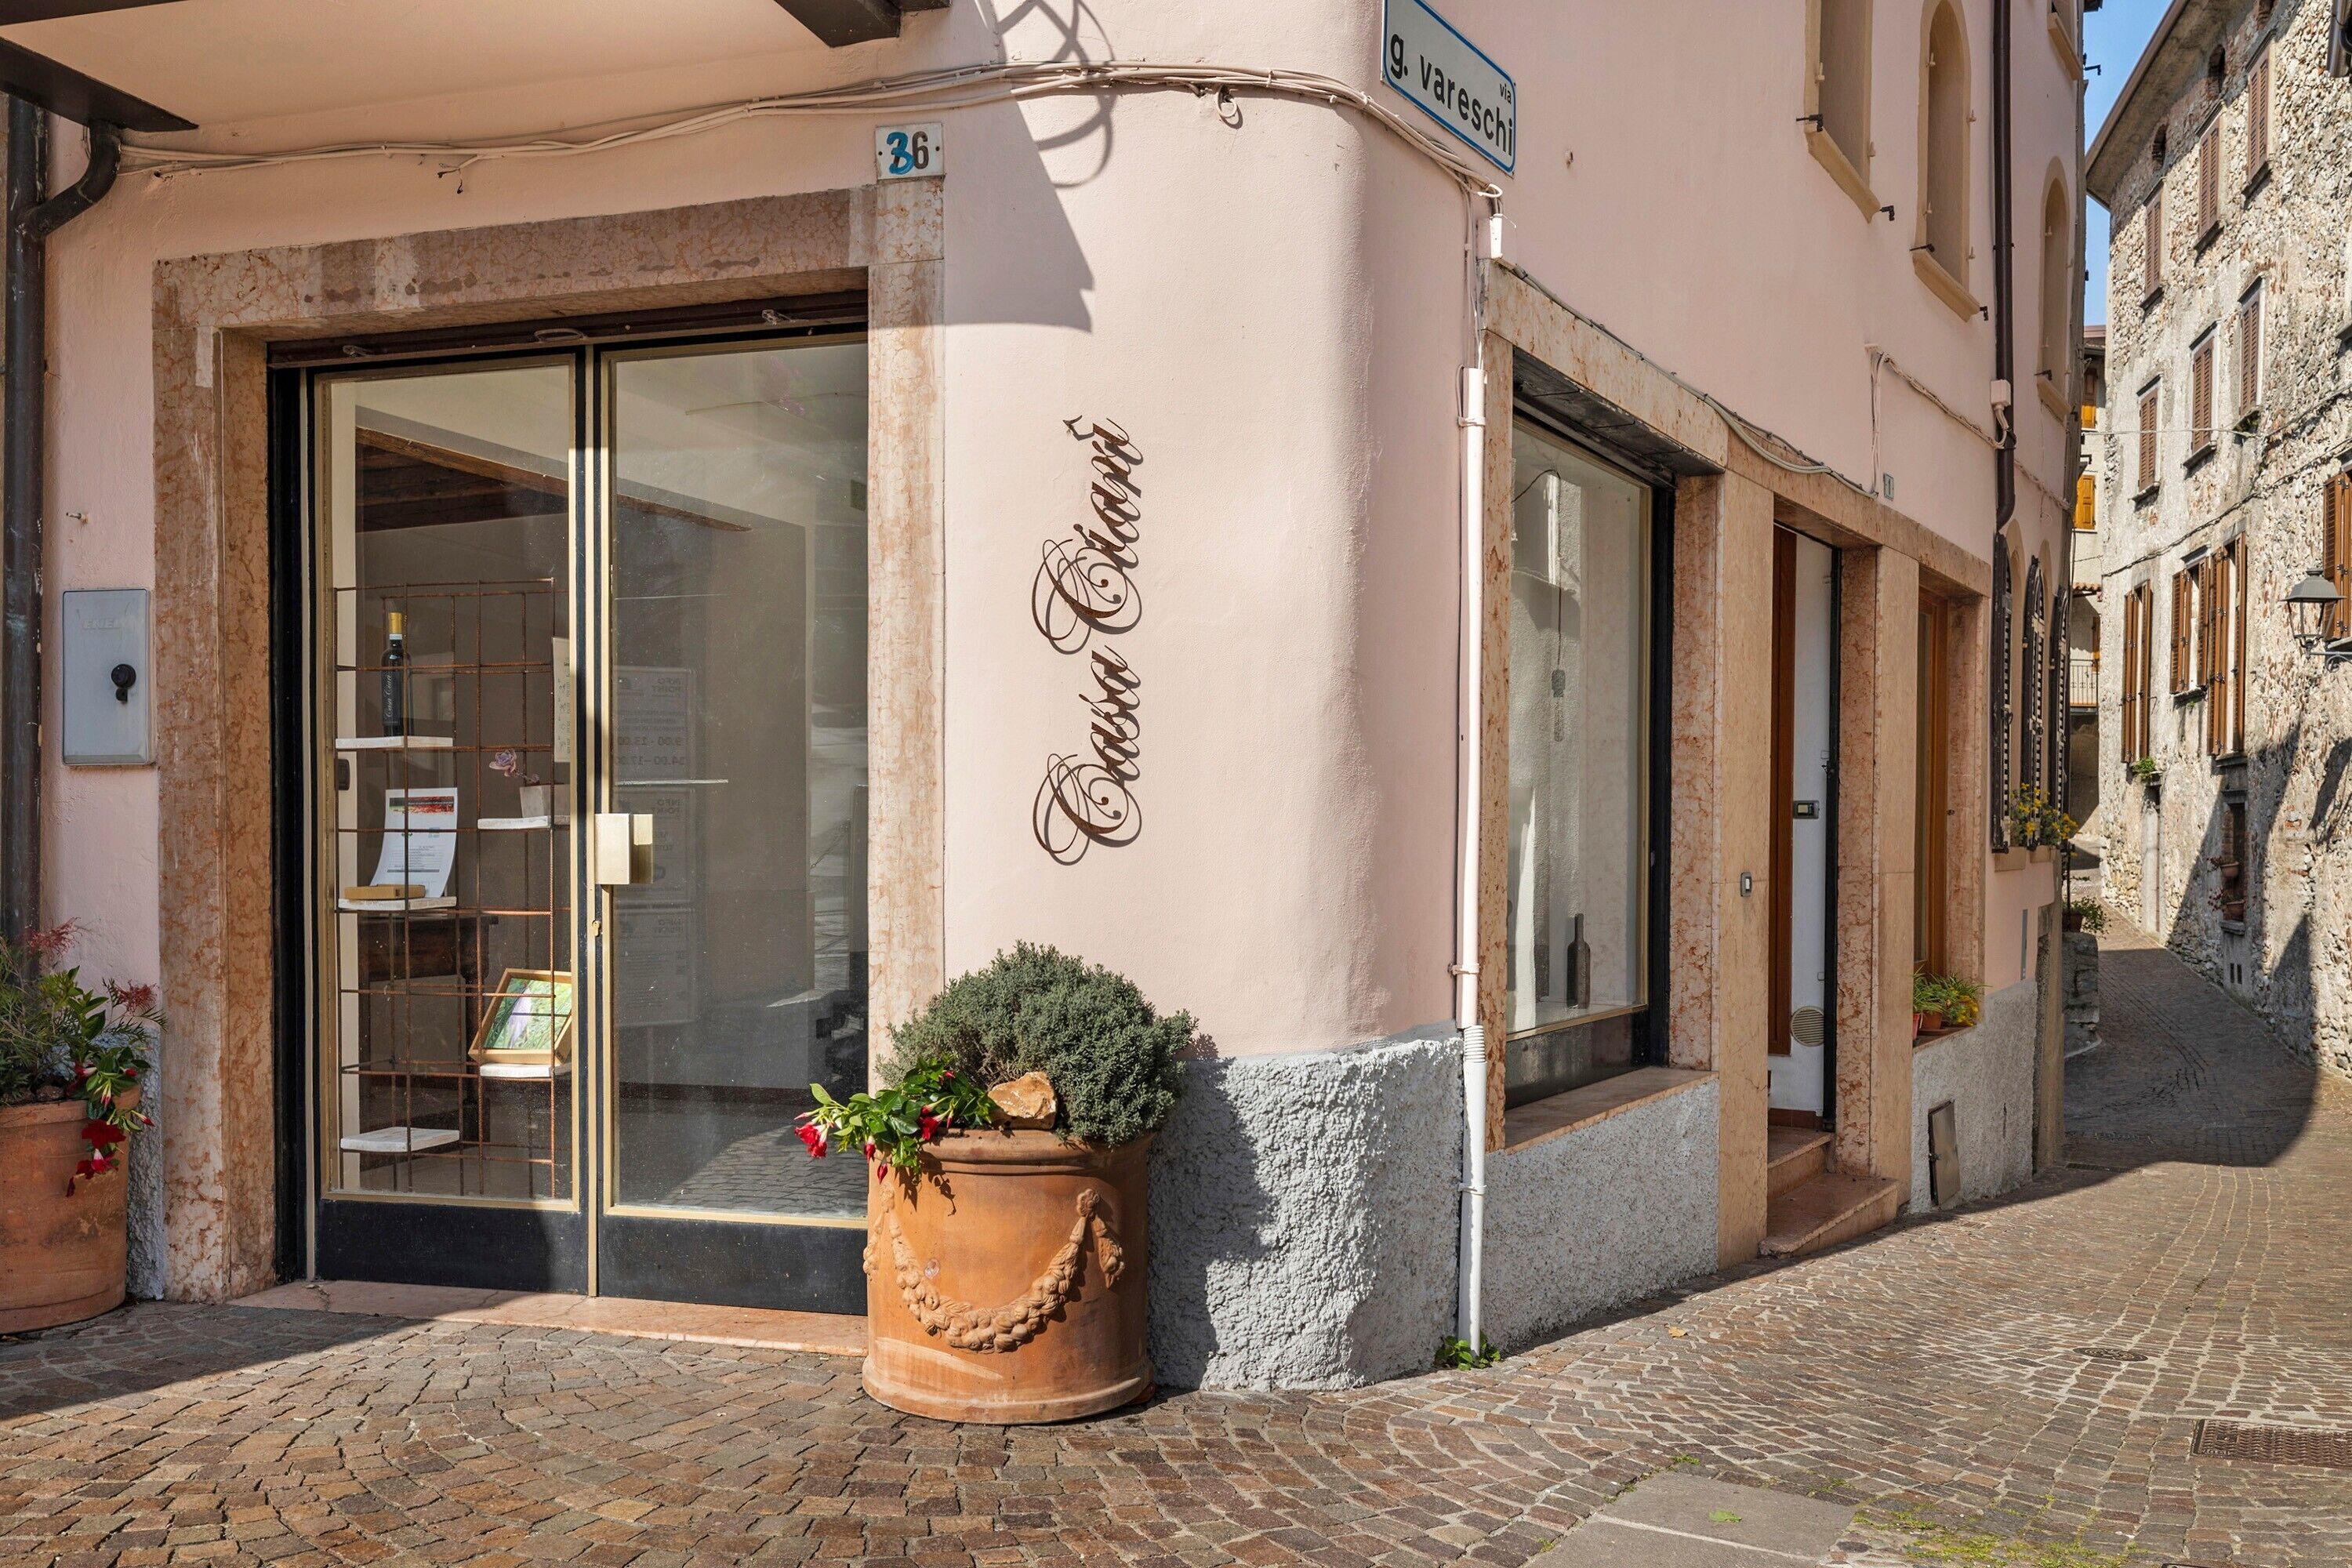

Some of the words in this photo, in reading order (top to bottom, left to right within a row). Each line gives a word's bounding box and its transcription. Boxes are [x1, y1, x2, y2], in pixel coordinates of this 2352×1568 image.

[1390, 34, 1408, 79] g.
[1420, 54, 1512, 156] vareschi
[1499, 83, 1512, 104] via
[1033, 645, 1131, 855] Casa
